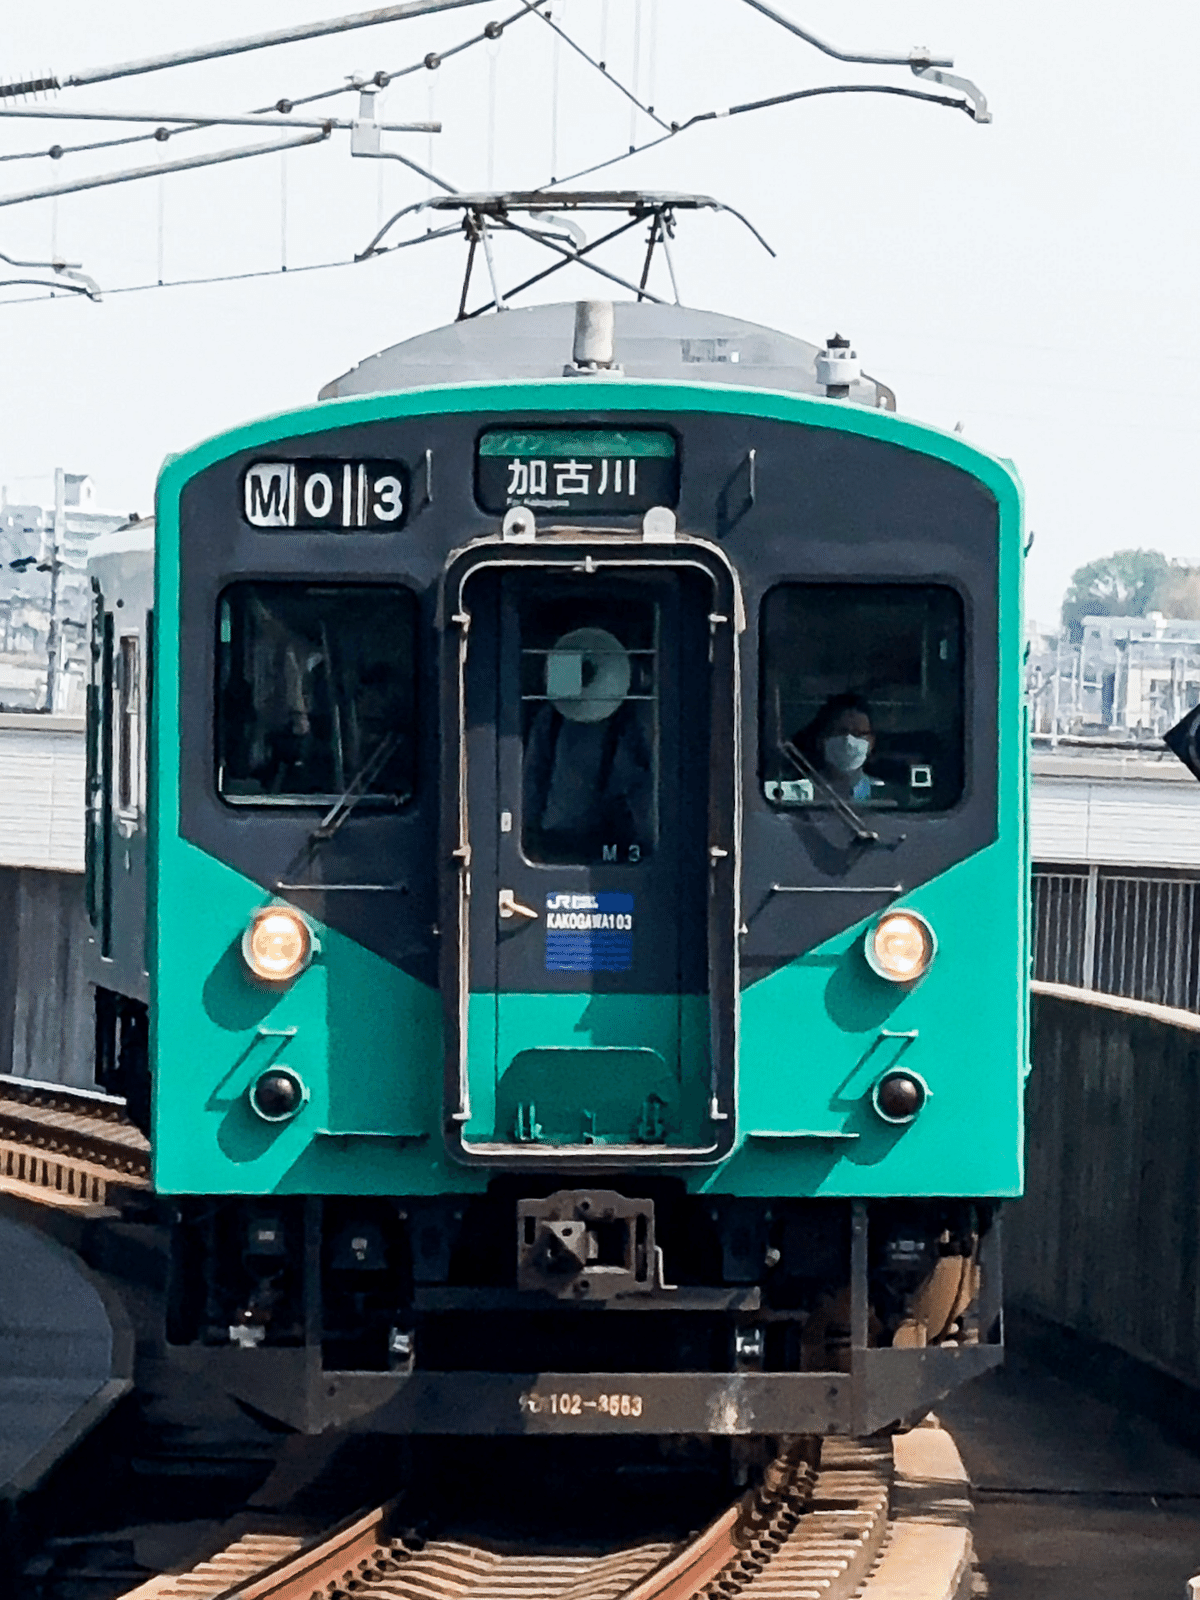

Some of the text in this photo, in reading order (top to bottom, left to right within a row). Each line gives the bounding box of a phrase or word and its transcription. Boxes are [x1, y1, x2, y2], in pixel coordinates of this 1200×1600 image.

[507, 458, 636, 495] 加古川
[603, 844, 641, 862] M 3
[546, 913, 632, 930] KAKOGAWA103
